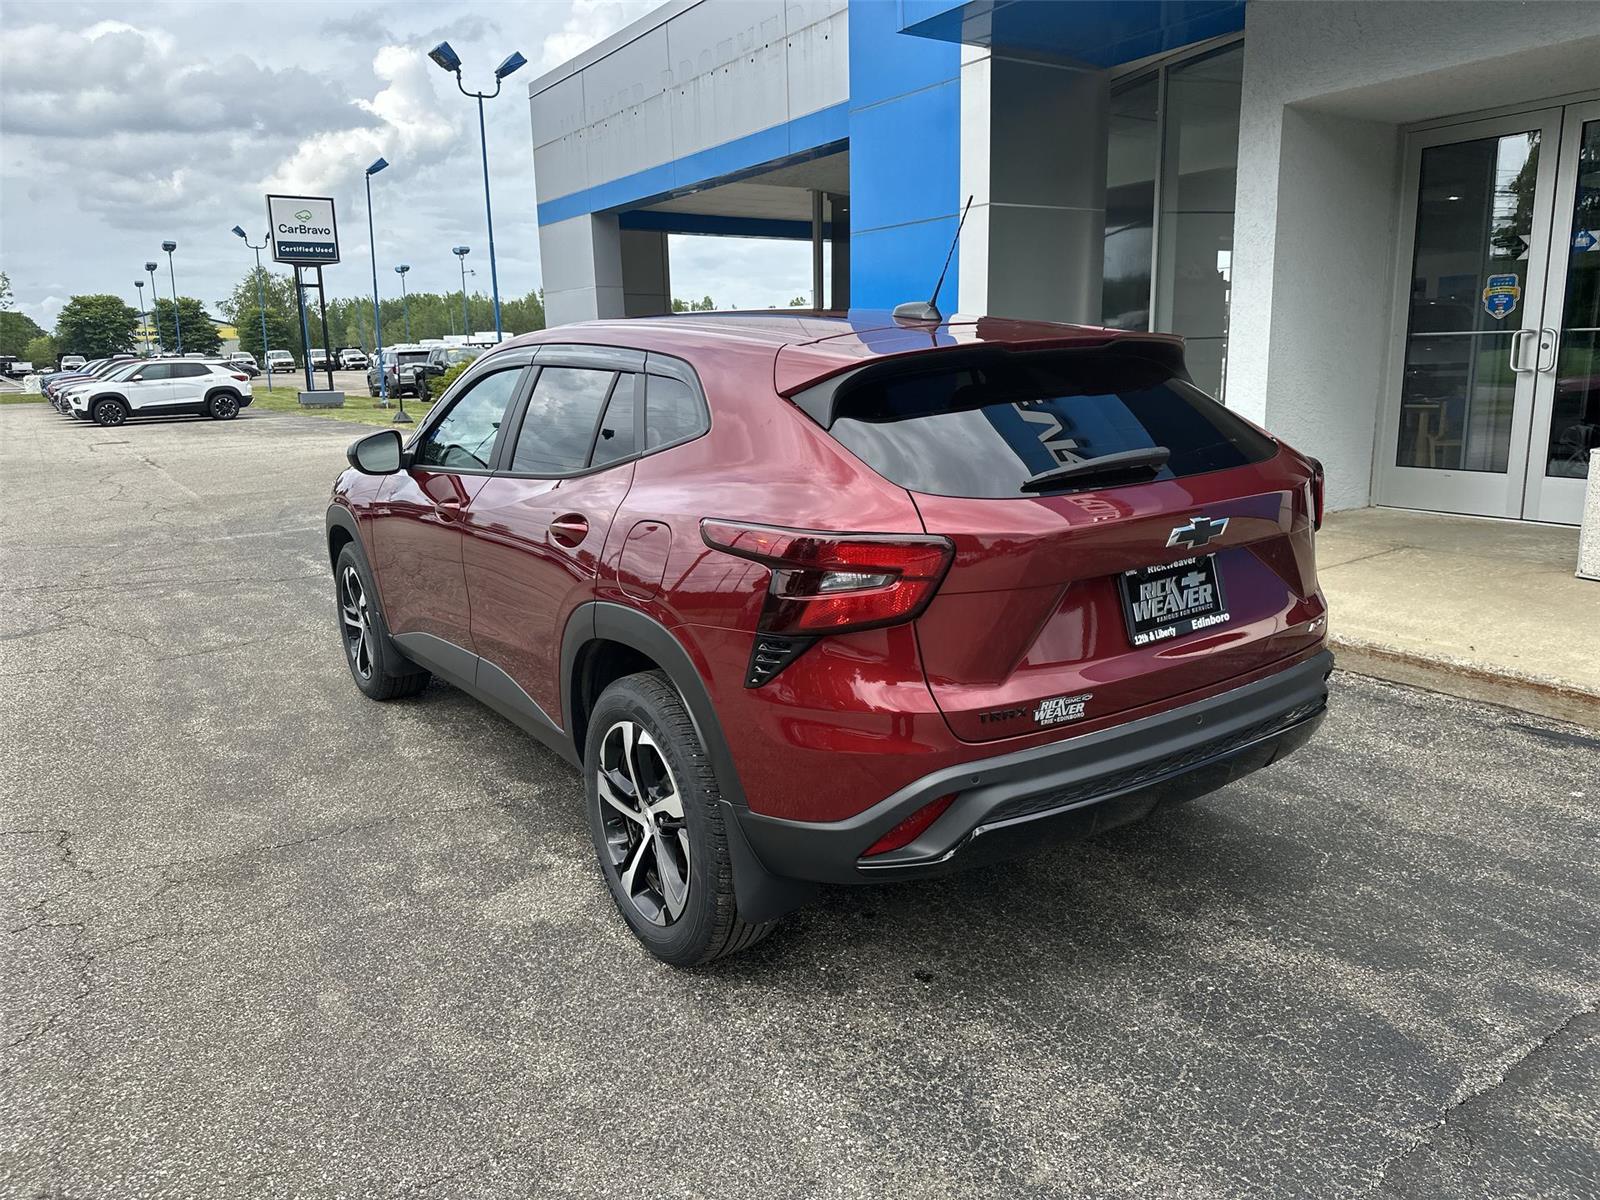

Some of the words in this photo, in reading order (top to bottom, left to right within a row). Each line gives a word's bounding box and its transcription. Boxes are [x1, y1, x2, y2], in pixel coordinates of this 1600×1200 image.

[278, 223, 331, 235] CarBravo
[280, 245, 313, 253] Certified
[1140, 576, 1179, 601] RICK
[1132, 583, 1213, 622] WEAVER
[1191, 602, 1213, 614] SERVICE
[1191, 613, 1230, 630] Edinboro
[1134, 633, 1149, 645] 12th
[1149, 631, 1156, 641] &
[1154, 626, 1176, 640] Liberty
[1034, 702, 1085, 722] WEAVER
[1040, 698, 1066, 711] RICK
[1056, 712, 1085, 723] EDINBORO
